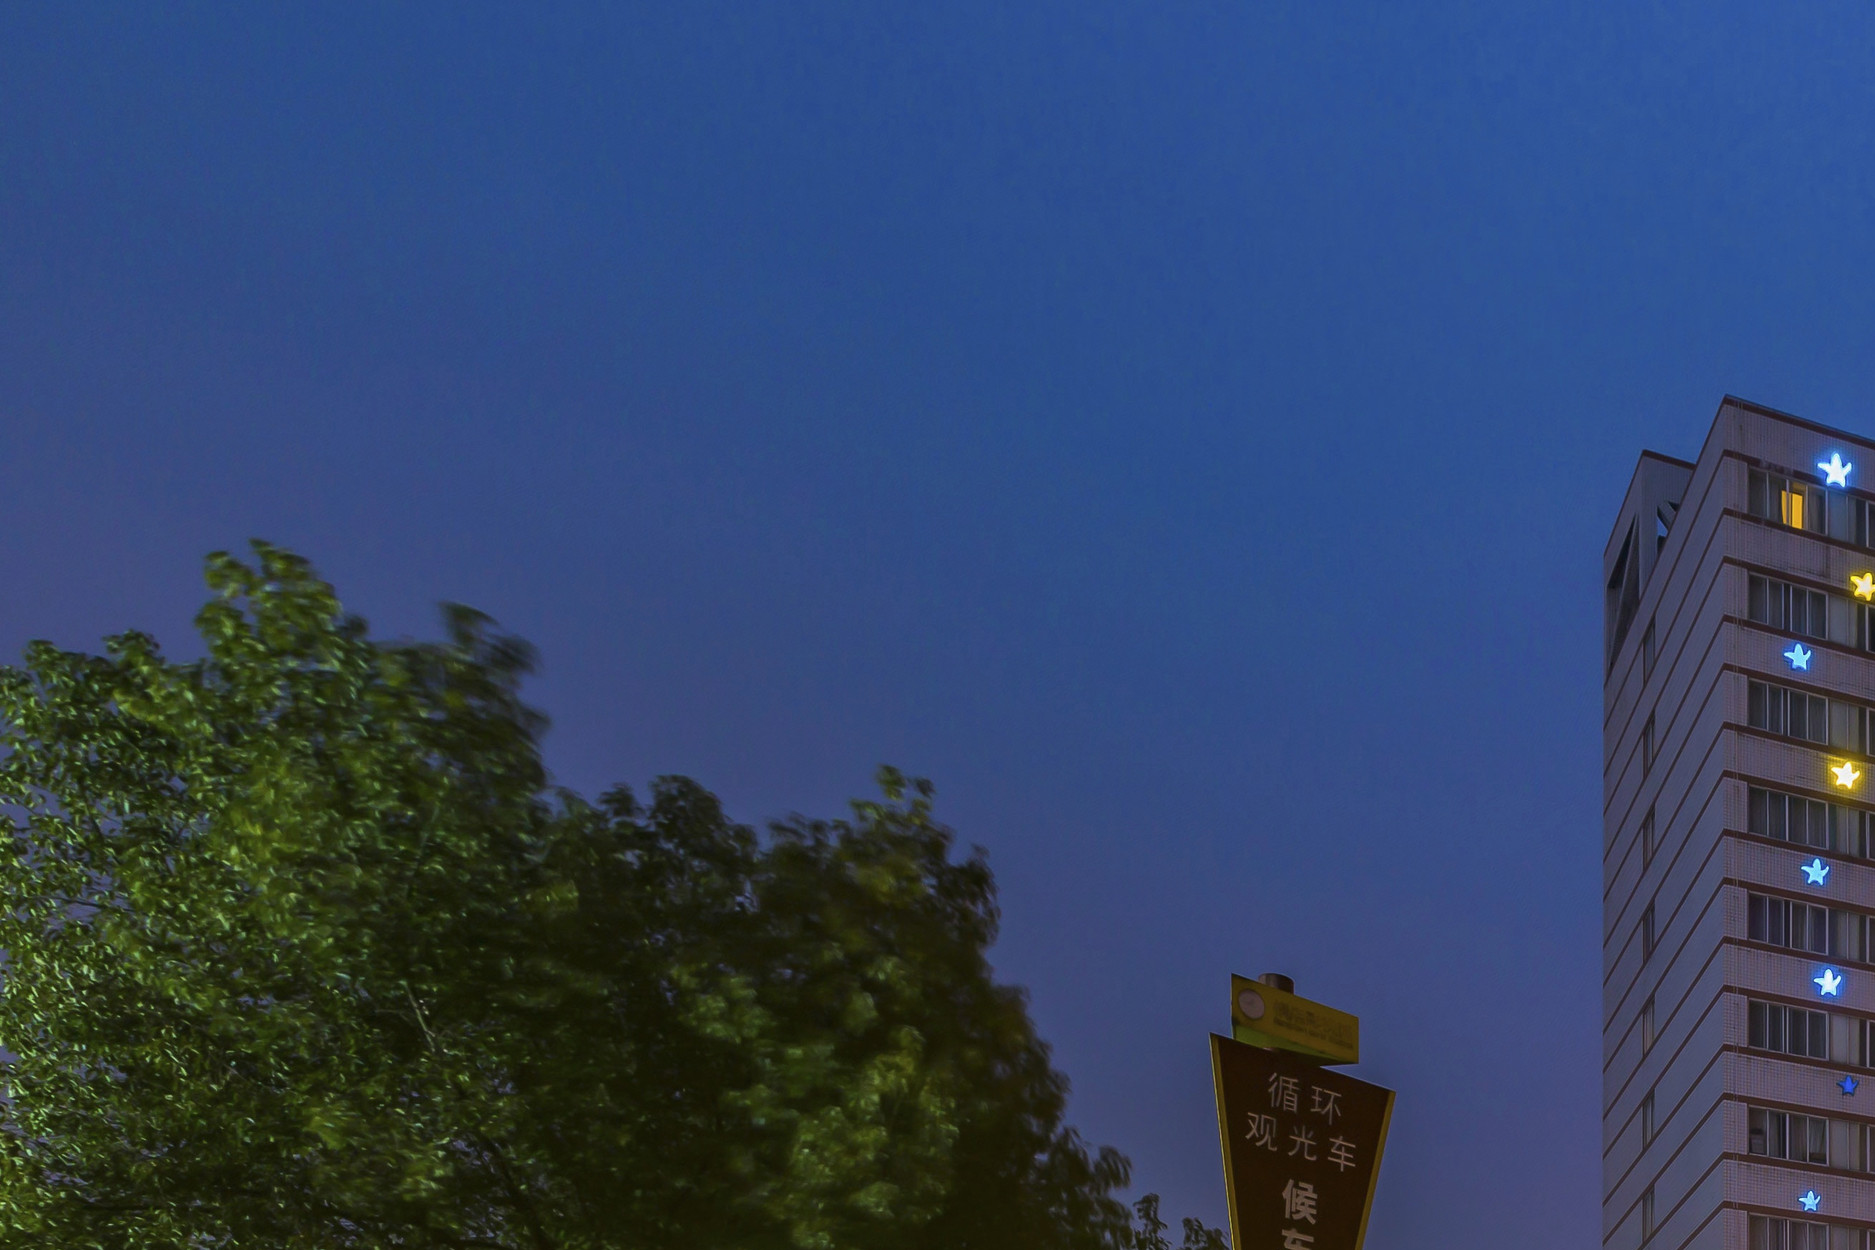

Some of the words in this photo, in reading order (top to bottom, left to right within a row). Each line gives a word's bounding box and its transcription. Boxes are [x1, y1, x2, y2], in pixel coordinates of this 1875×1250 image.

[1267, 1071, 1343, 1126] 循环
[1245, 1111, 1357, 1173] 观光车
